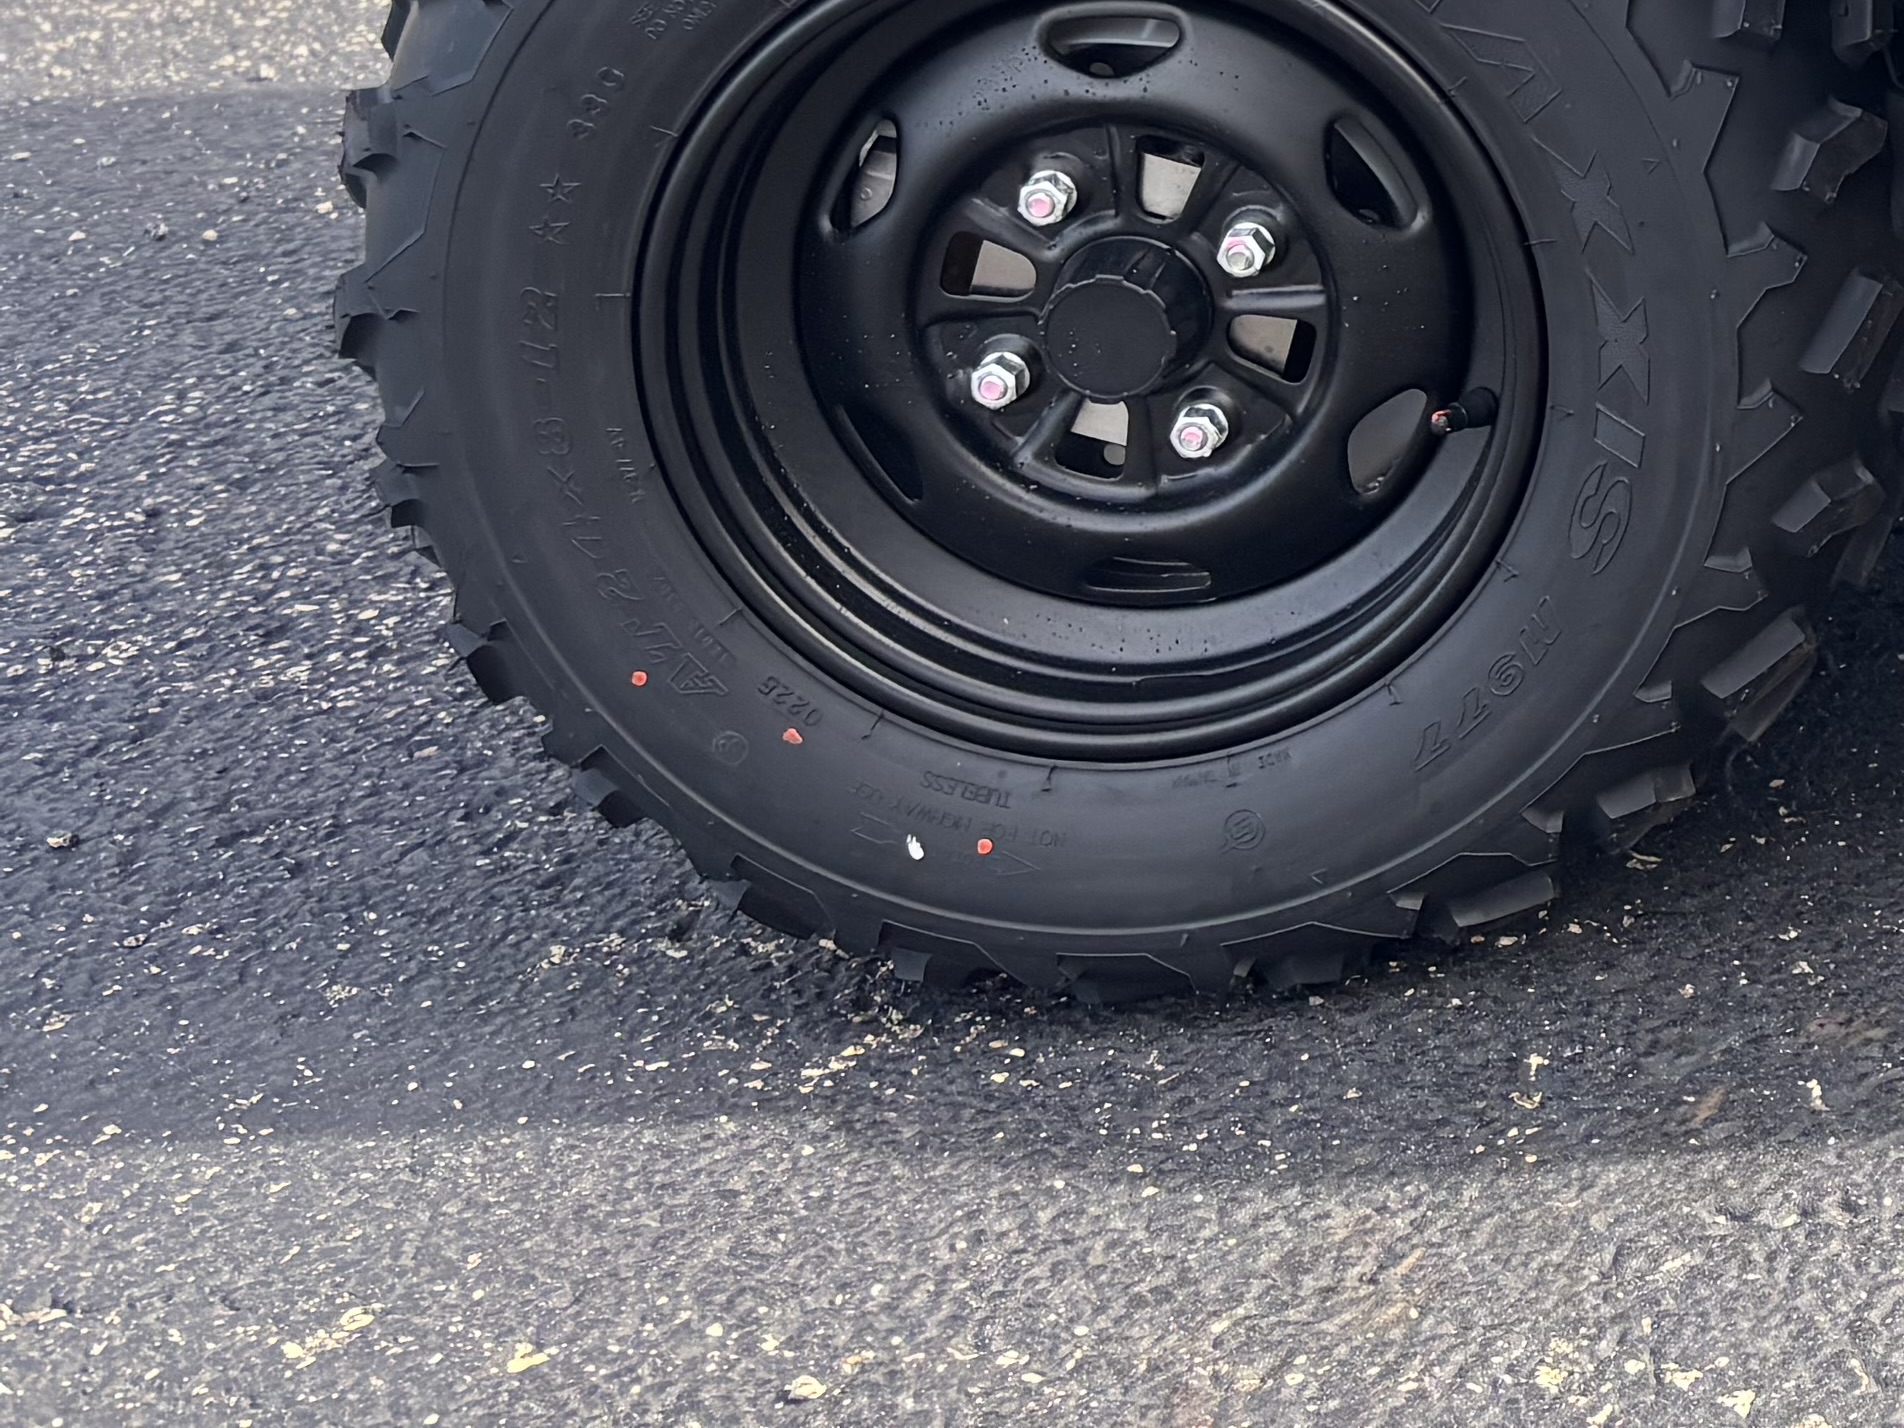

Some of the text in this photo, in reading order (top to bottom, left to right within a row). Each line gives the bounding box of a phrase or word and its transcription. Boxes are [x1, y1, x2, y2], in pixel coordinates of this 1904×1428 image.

[757, 676, 824, 728] 0225
[1414, 595, 1566, 769] M977
[917, 769, 1013, 809] TUBELESS
